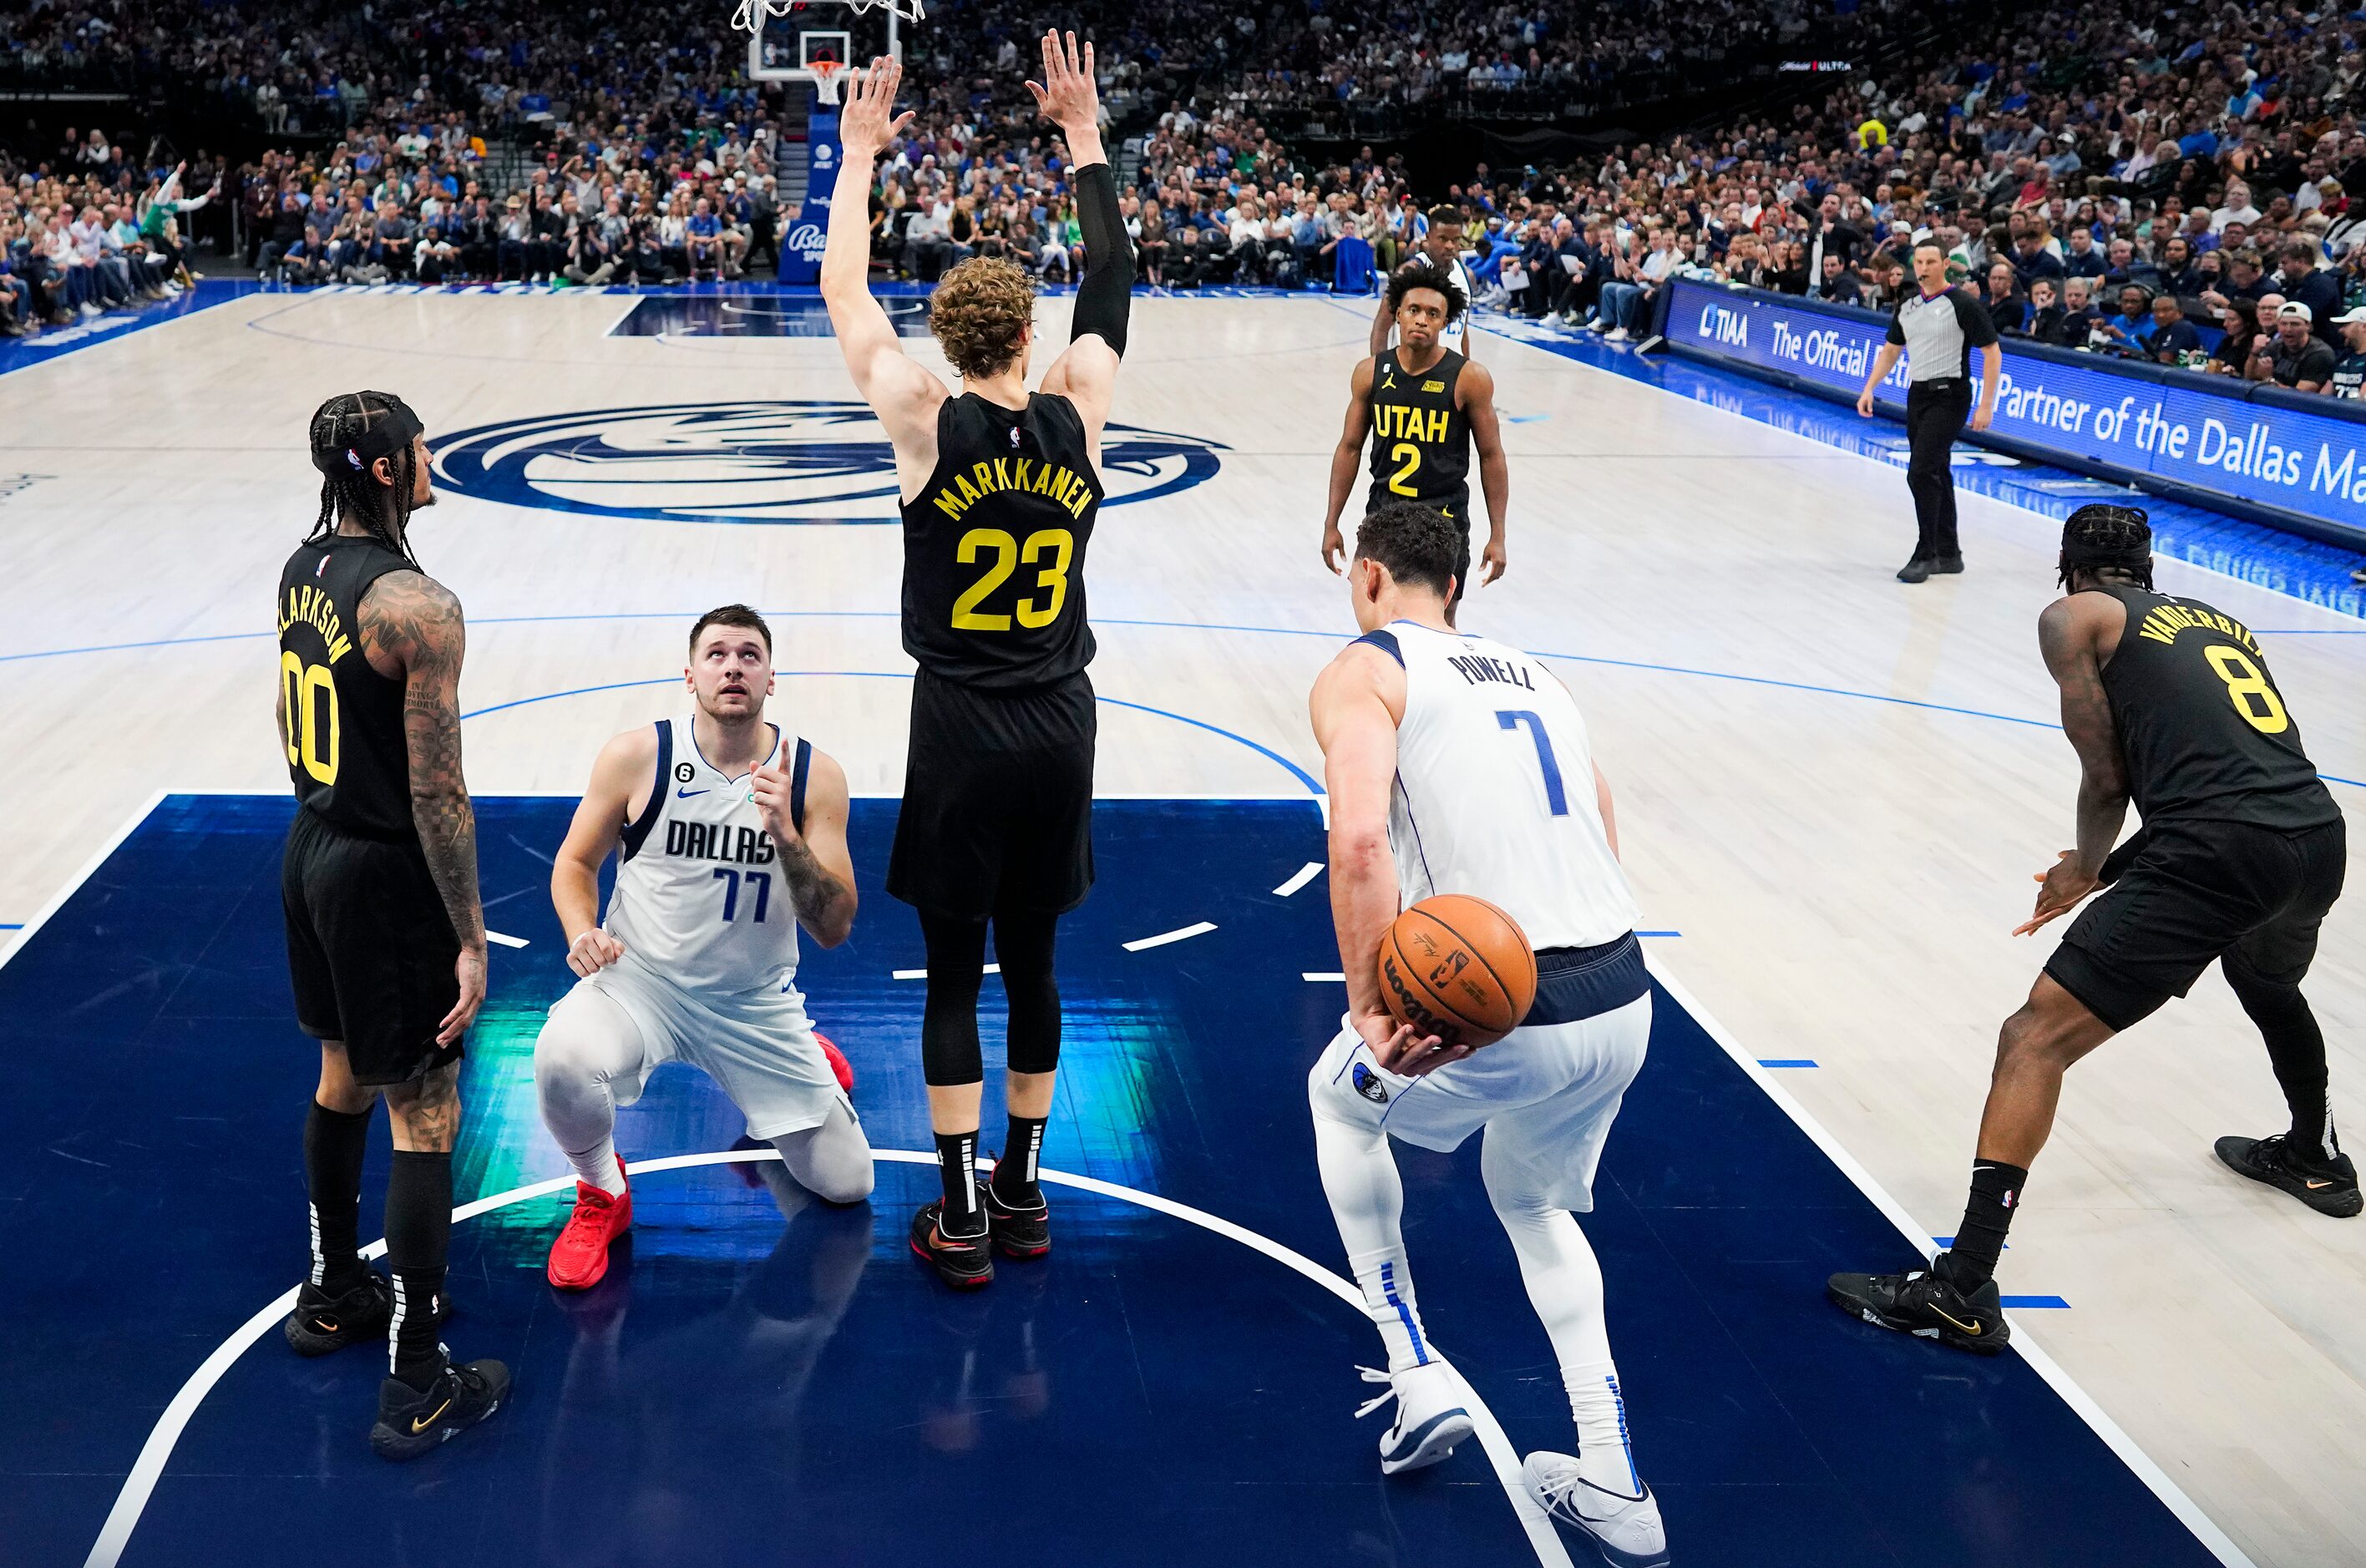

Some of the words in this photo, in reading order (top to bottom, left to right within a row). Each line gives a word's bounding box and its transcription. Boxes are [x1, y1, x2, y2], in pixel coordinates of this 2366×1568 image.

[1715, 308, 1748, 348] TIAA
[1772, 321, 1802, 361] The
[1804, 329, 1871, 378] Official
[1374, 404, 1450, 443] UTAH
[1994, 372, 2090, 432] Partner
[2094, 396, 2135, 443] of
[2135, 402, 2190, 459] the
[2196, 417, 2303, 486] Dallas
[2309, 443, 2366, 504] Ma
[933, 457, 1093, 522] MARKKANEN
[1389, 443, 1421, 498] 2
[951, 528, 1074, 631] 23
[2139, 604, 2262, 657] VANDERBIL
[1447, 655, 1536, 692] POWELL
[2204, 645, 2288, 734] 8
[281, 650, 341, 787] 00
[678, 765, 691, 781] 6
[1494, 710, 1570, 818] 7
[665, 818, 775, 865] DALLAS
[712, 867, 773, 923] 77
